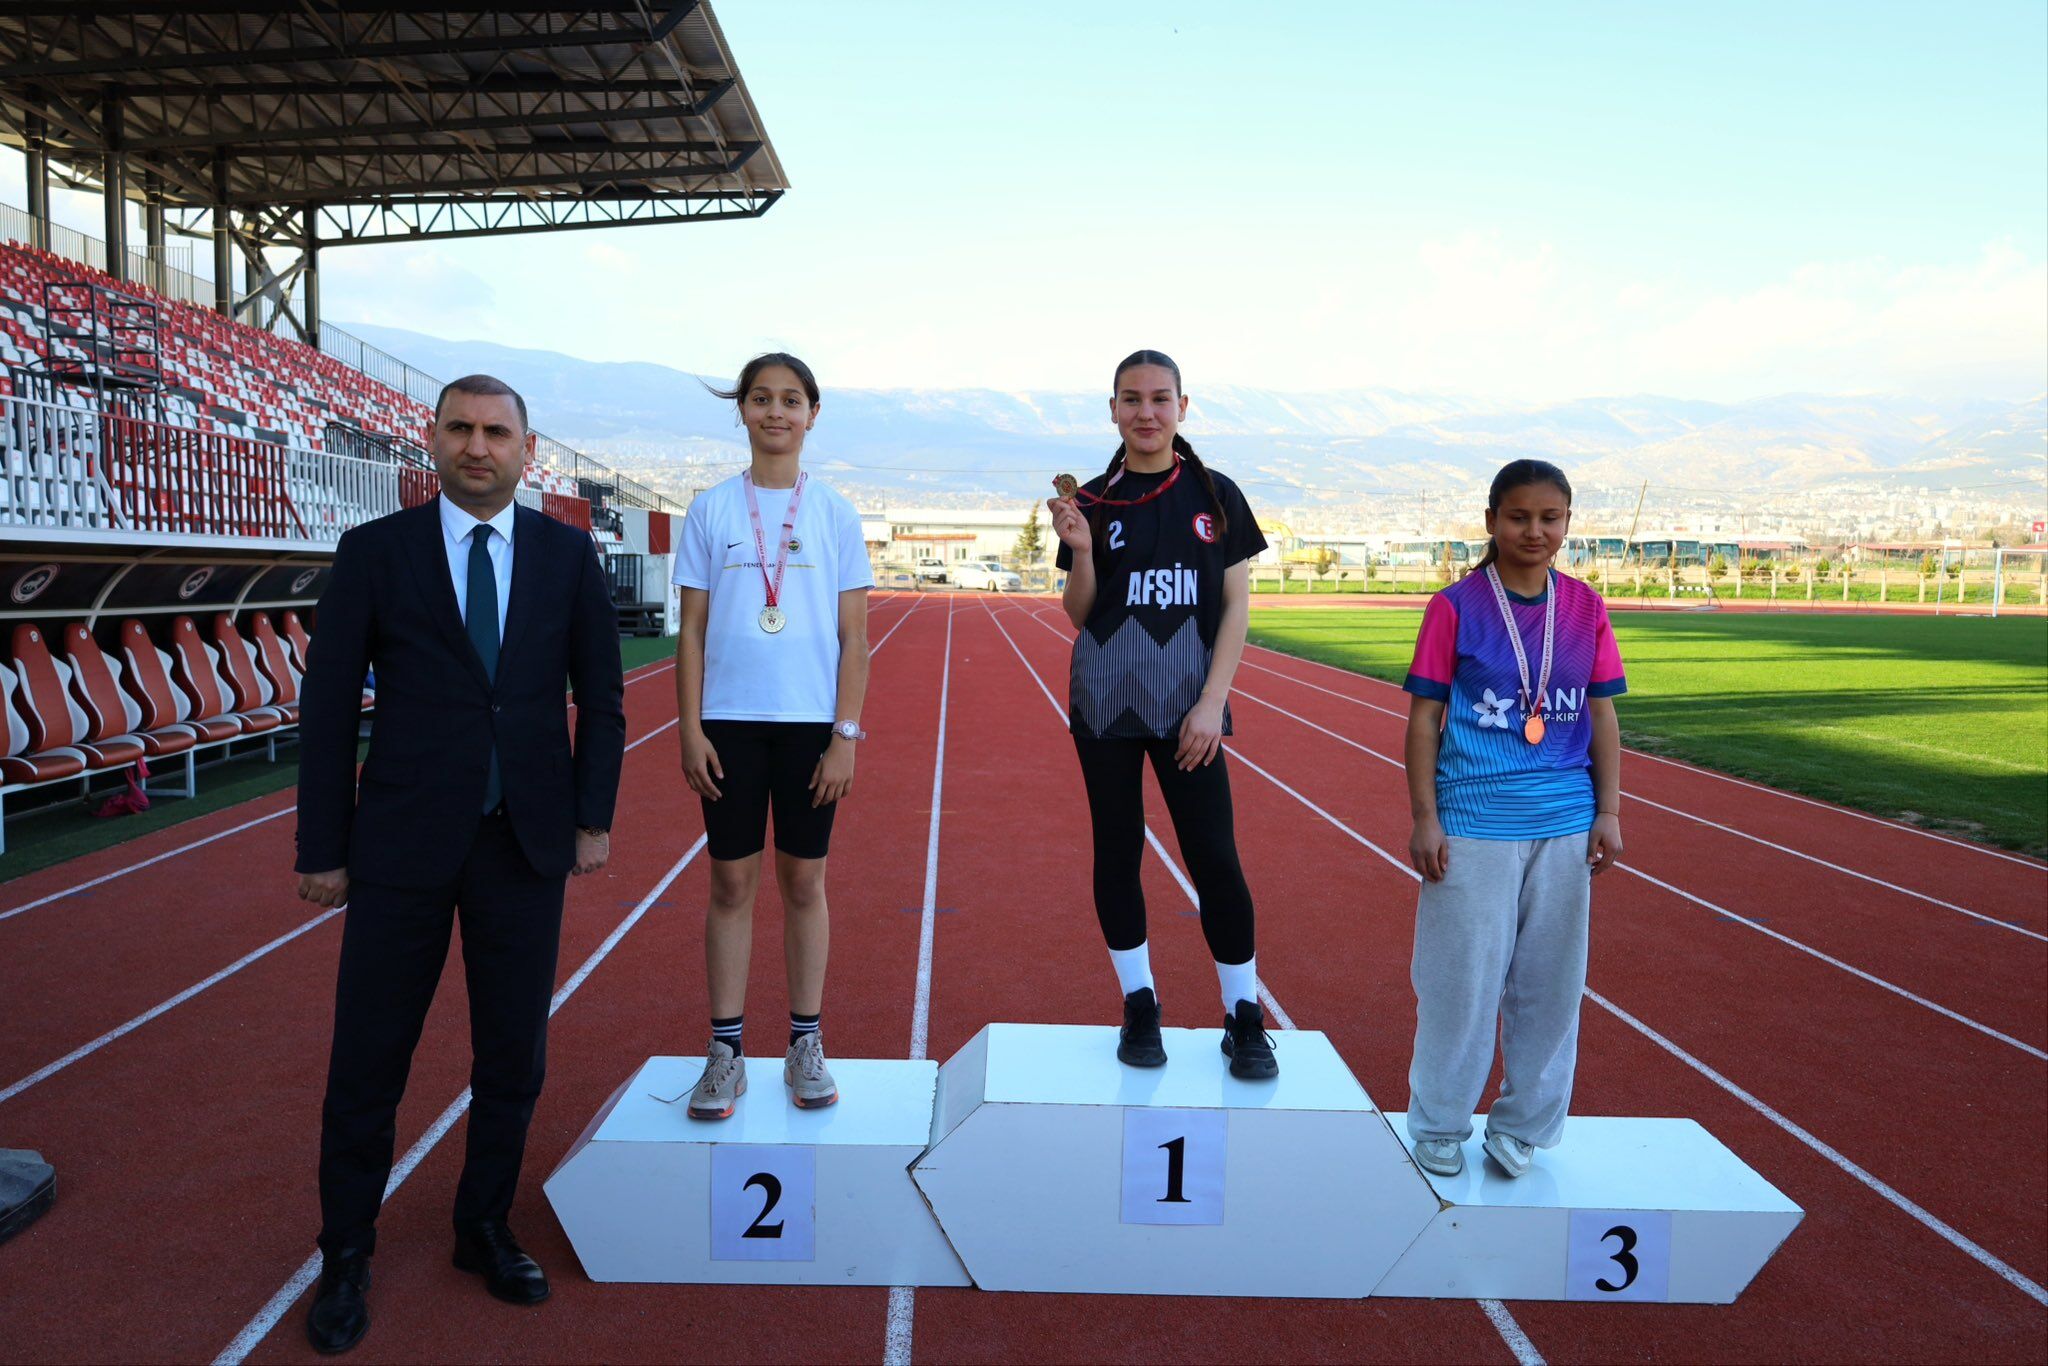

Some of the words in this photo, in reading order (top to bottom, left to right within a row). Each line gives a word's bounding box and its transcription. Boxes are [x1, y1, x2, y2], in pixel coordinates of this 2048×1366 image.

[1108, 520, 1126, 551] 2
[1126, 562, 1198, 610] AFŞİN
[1157, 1136, 1192, 1203] 1
[742, 1173, 784, 1239] 2
[1595, 1226, 1638, 1292] 3
